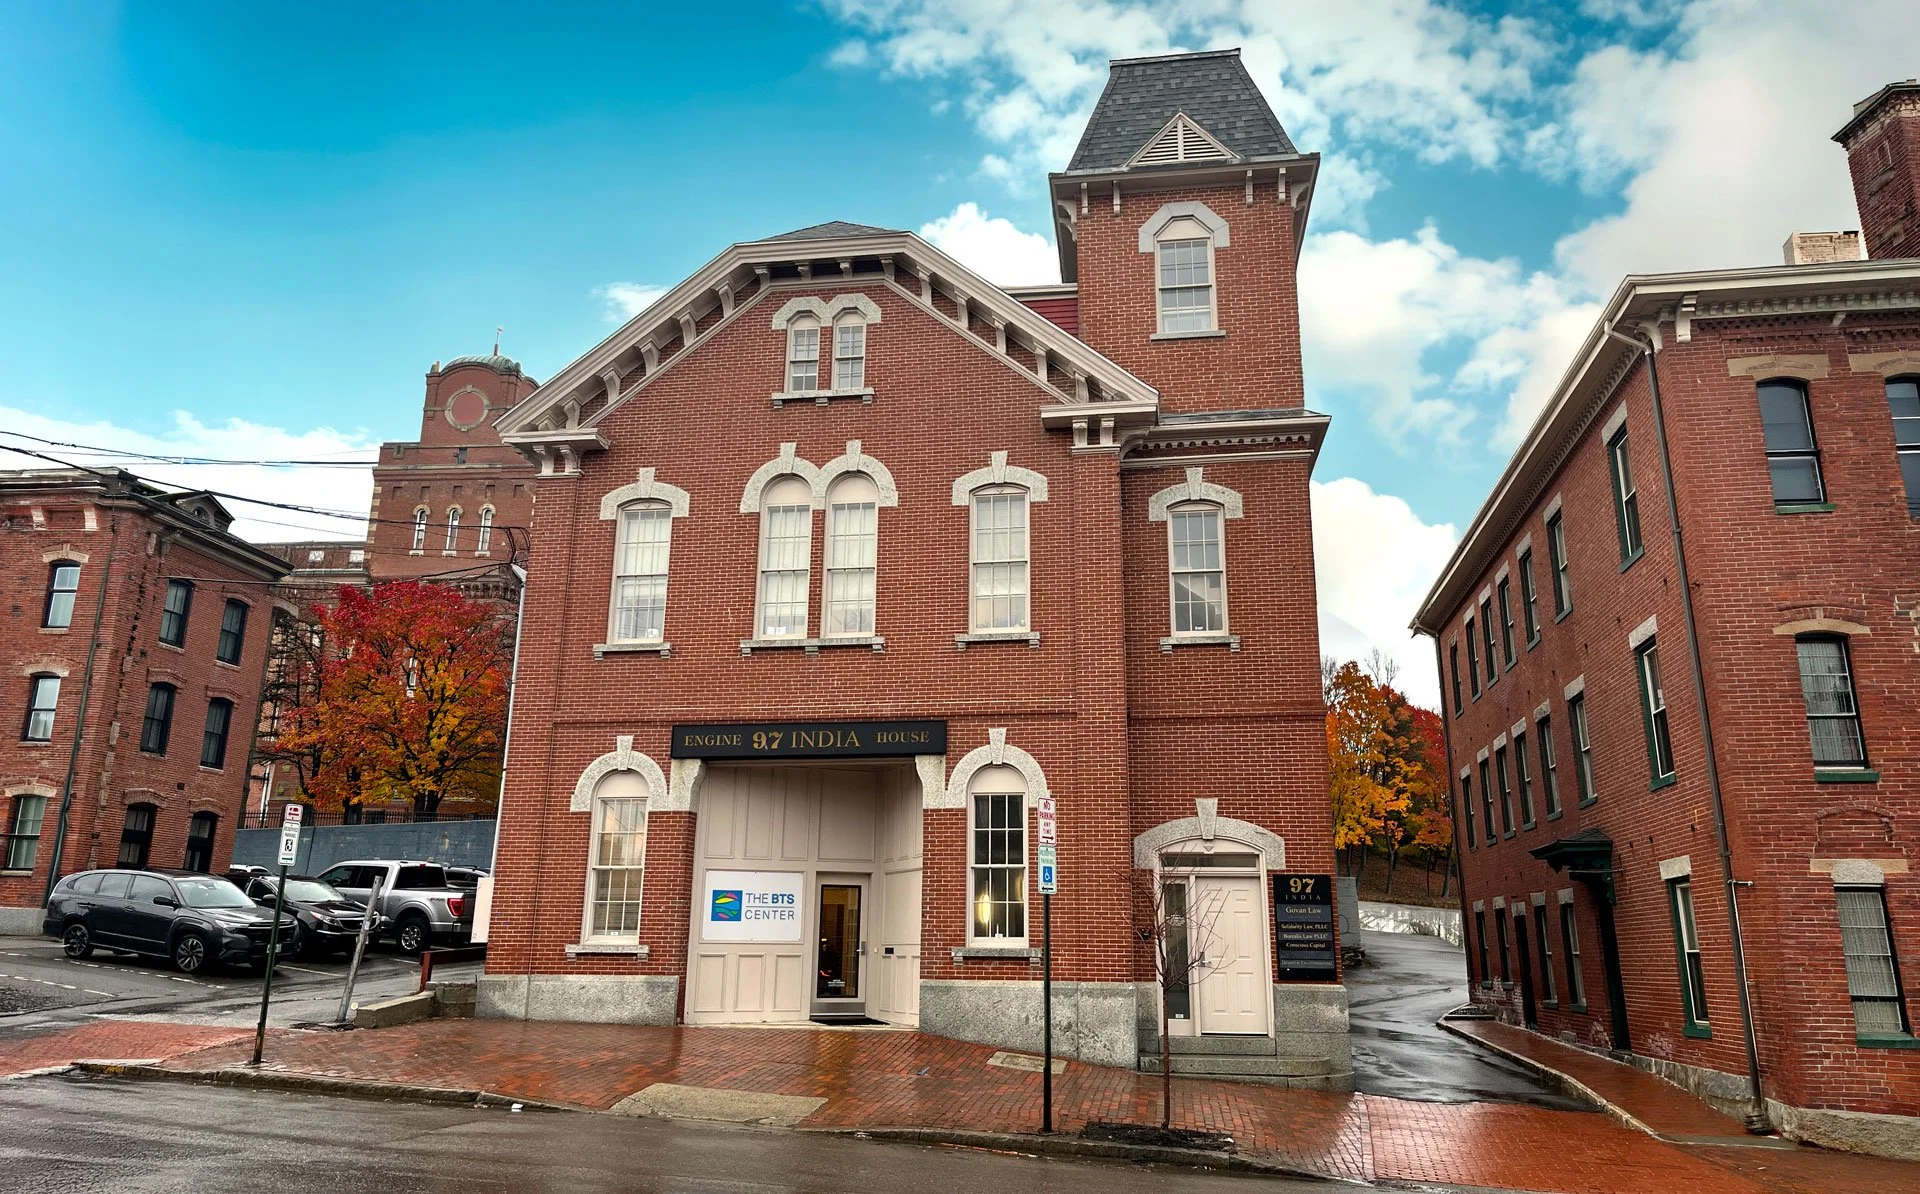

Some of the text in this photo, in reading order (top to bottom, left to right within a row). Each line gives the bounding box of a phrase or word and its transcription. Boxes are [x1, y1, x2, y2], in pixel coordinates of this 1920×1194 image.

[684, 730, 930, 750] ENGINE 97 INDIA HOUSE
[1043, 801, 1051, 810] NO
[1290, 878, 1315, 893] 97
[746, 893, 795, 904] THE BTS
[745, 910, 795, 920] CENTER
[1285, 906, 1307, 914] Govan
